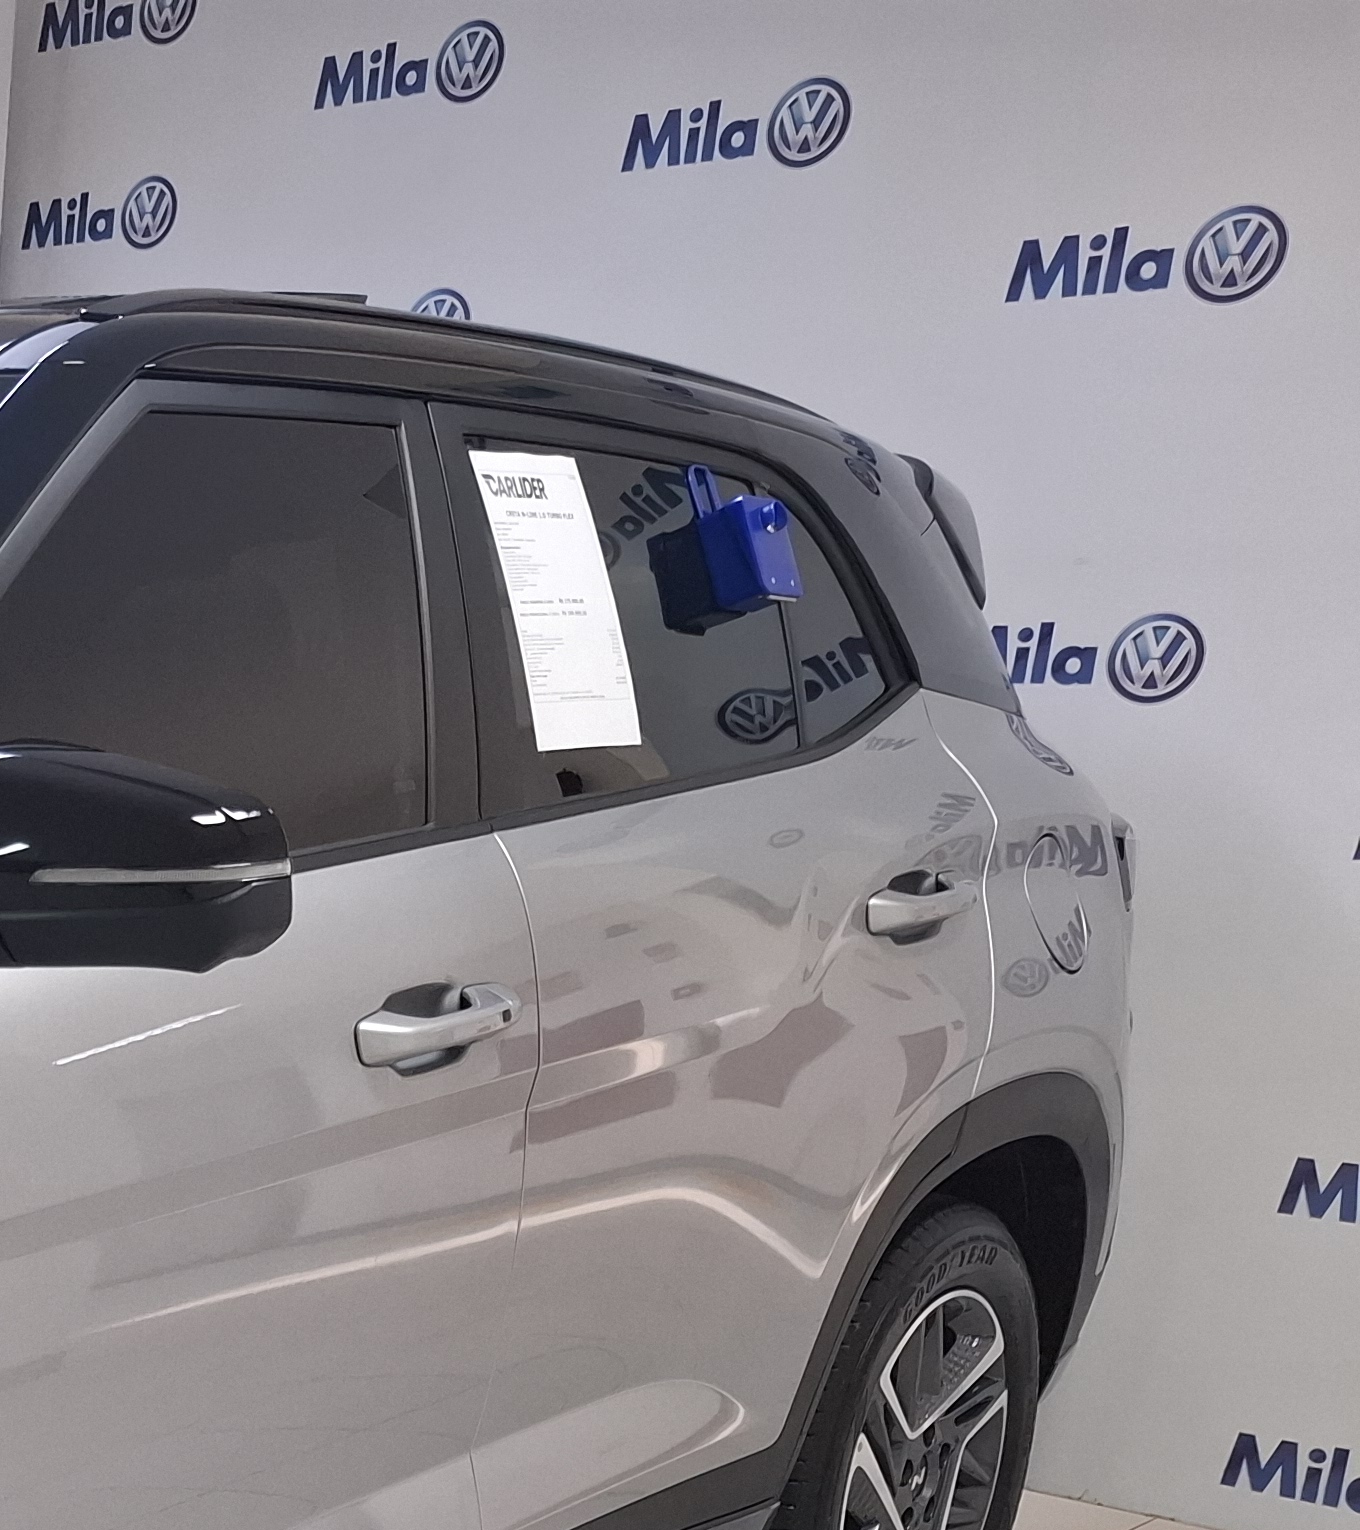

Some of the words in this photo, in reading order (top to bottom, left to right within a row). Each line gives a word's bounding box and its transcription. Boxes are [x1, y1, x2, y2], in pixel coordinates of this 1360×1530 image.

[38, 0, 133, 53] Mila
[314, 42, 428, 110] Mila
[621, 100, 759, 172] Mila
[21, 192, 115, 250] Mila
[1005, 226, 1174, 303] Mila
[480, 473, 549, 500] CARLIDER
